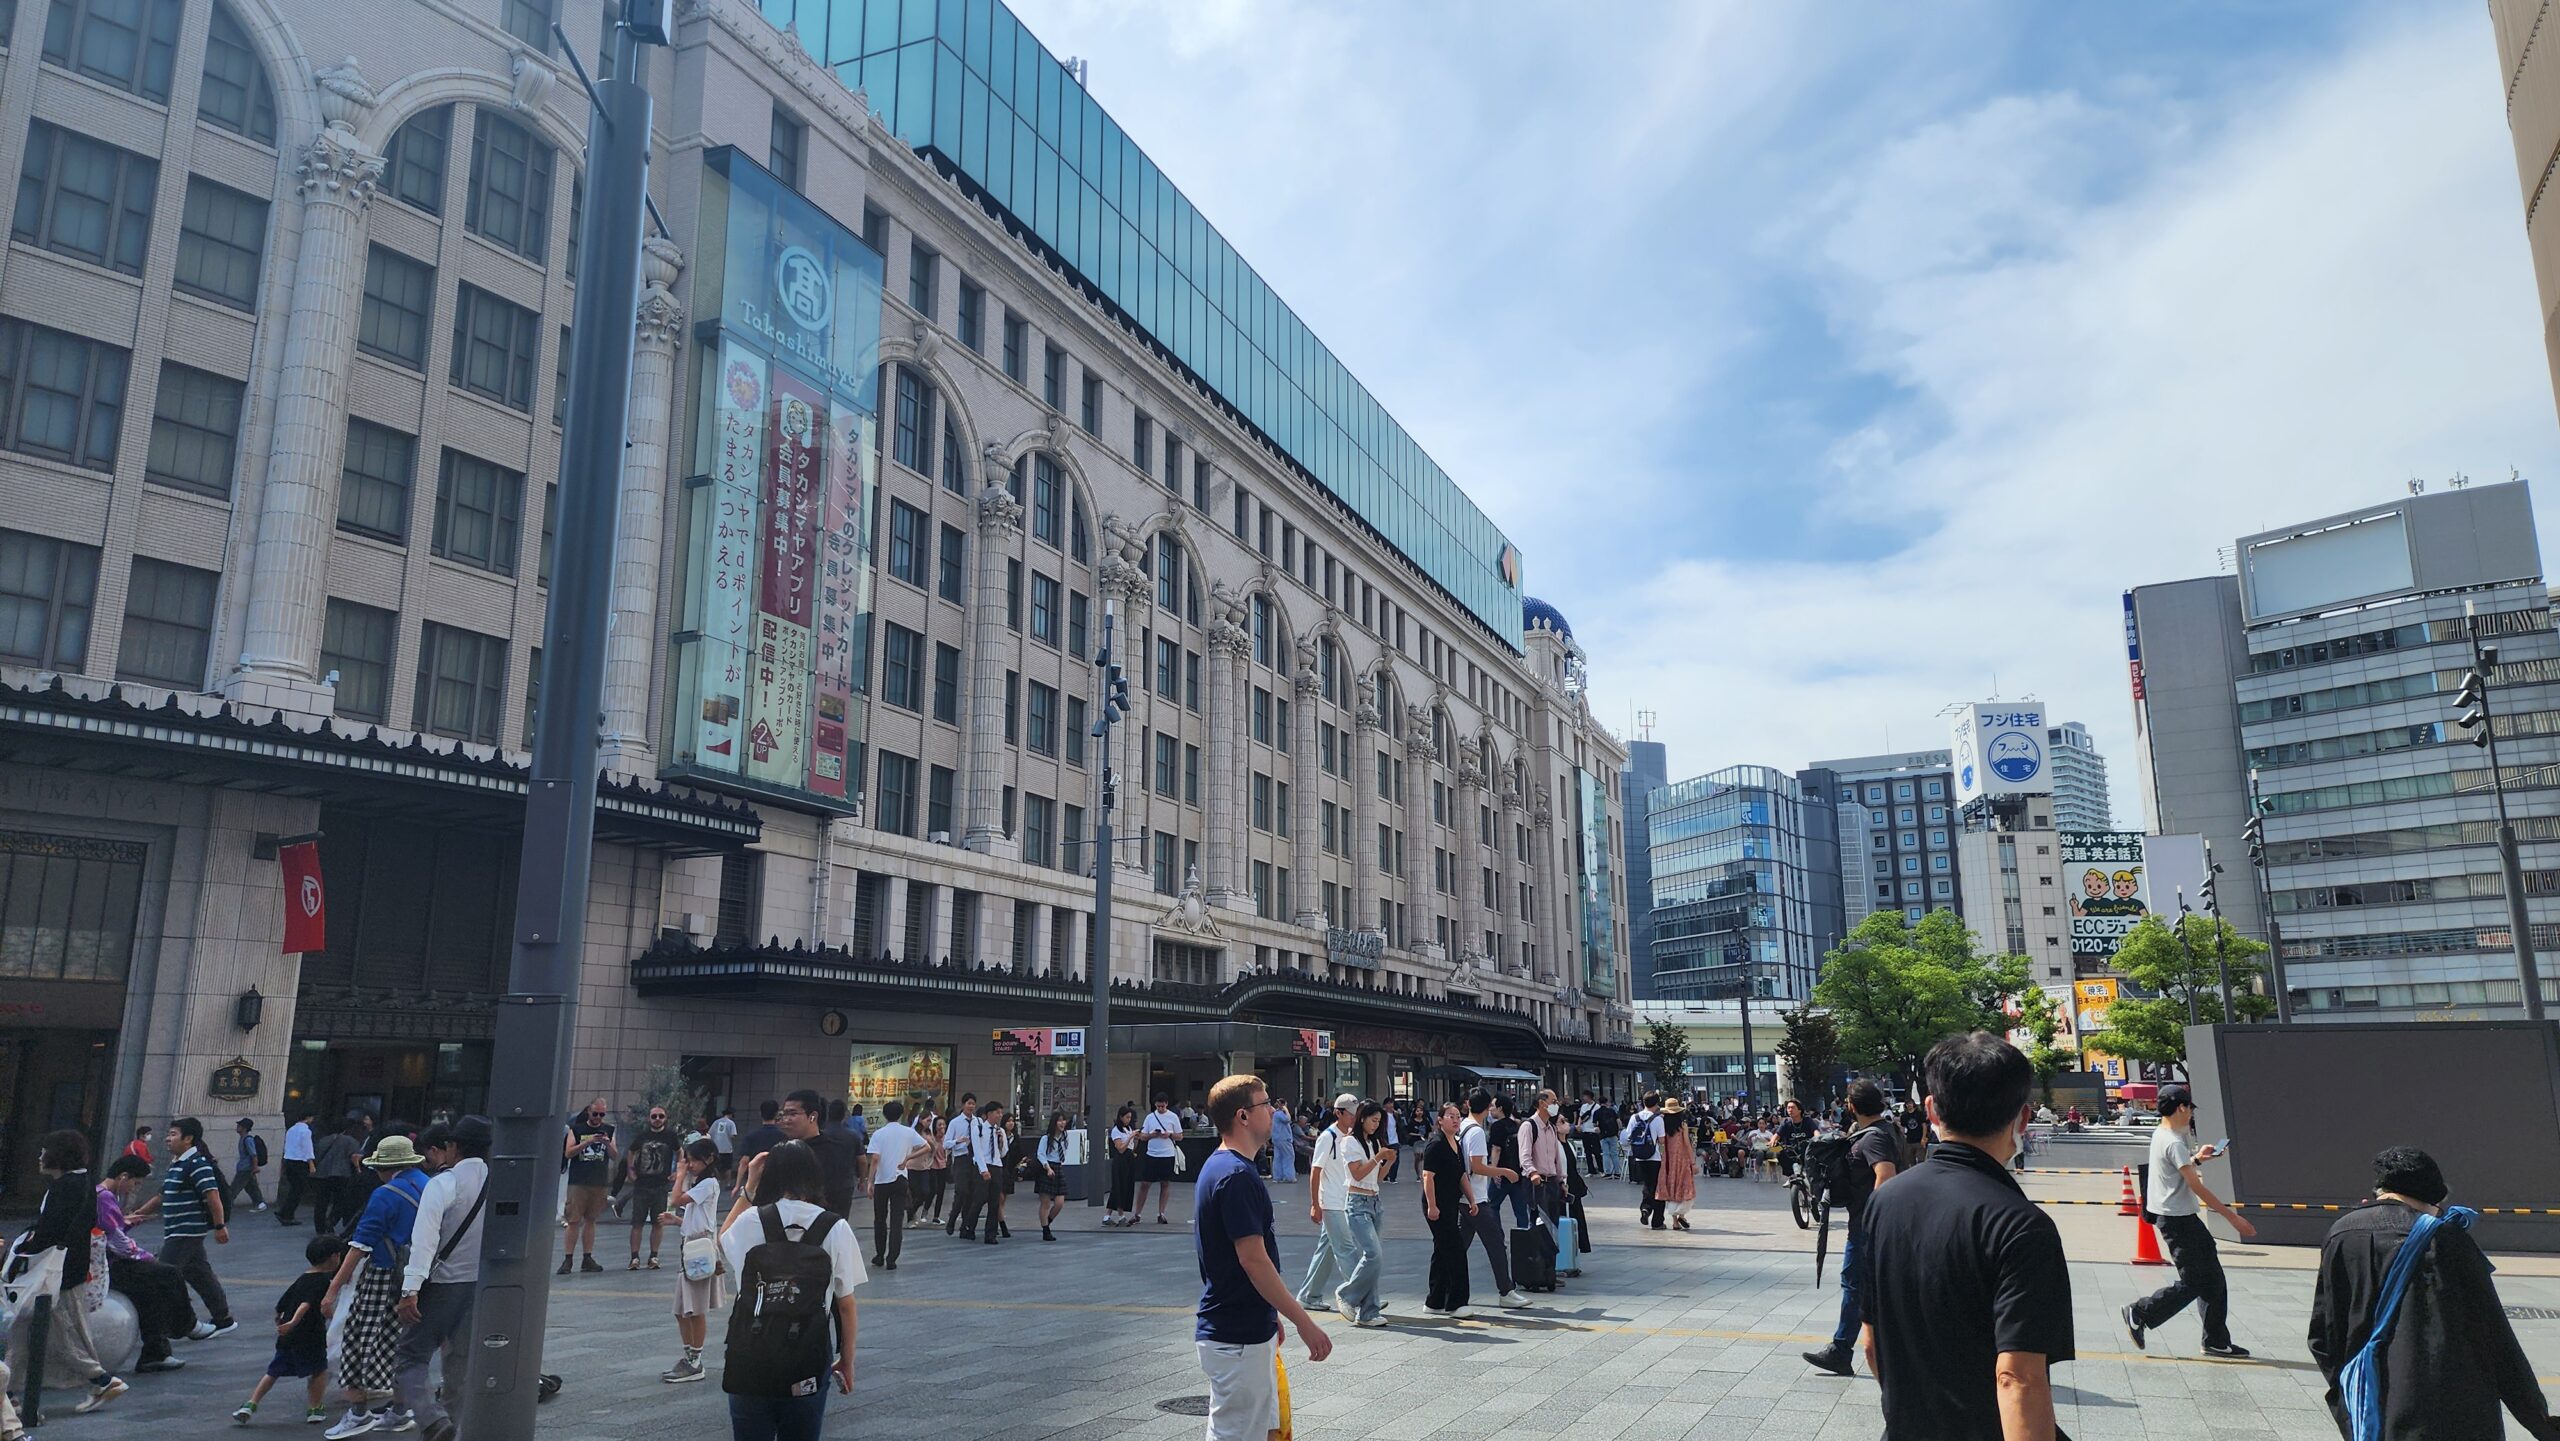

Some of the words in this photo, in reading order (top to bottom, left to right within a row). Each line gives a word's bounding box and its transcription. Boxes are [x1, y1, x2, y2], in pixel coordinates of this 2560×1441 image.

[739, 299, 857, 389] Takashimaya
[716, 411, 741, 591] たまる・つかえる
[724, 423, 755, 684] タカシマヤでdポイントが
[789, 451, 811, 616] タカシマヤアプリ
[836, 429, 859, 692] タカシマヤのクレジットカード
[775, 625, 789, 738] ポイントアップクーポン
[786, 628, 798, 726] タカシマヤのカード
[1981, 713, 2040, 727] フジ住宅
[756, 744, 767, 754] UP
[849, 1077, 909, 1098] 大北海道展
